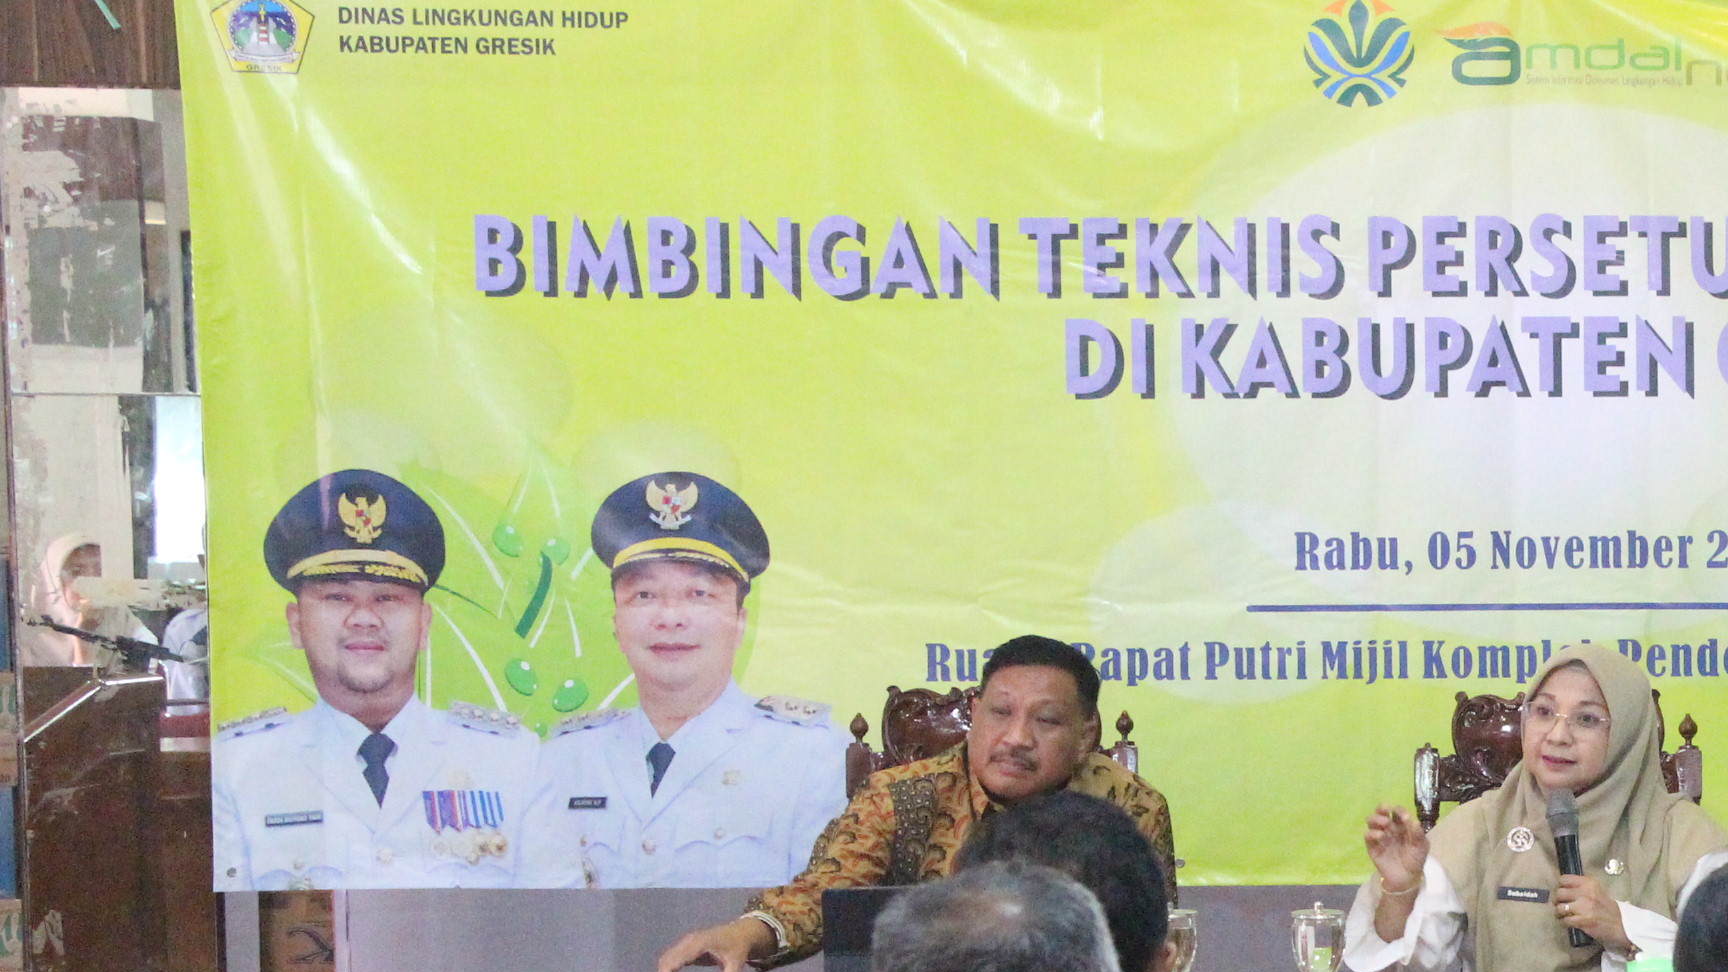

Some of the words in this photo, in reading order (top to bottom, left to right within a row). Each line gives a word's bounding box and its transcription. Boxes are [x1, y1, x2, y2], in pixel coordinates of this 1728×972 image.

[338, 7, 405, 25] DINAS
[412, 8, 554, 28] LINGKUNGAN
[561, 11, 629, 29] HIDUP
[339, 36, 468, 54] KABUPATEN
[475, 37, 556, 55] GRESIK
[473, 213, 1000, 302] BIMBINGAN
[1018, 212, 1346, 300] TEKNIS
[1064, 317, 1156, 400] DI
[1180, 315, 1695, 400] KABUPATEN
[1294, 530, 1414, 576] Rabu,
[1427, 530, 1478, 571] 05
[1490, 529, 1694, 570] November
[1203, 640, 1308, 681] Putri
[1321, 640, 1409, 686] Mijil
[1422, 639, 1590, 684] Kompl
